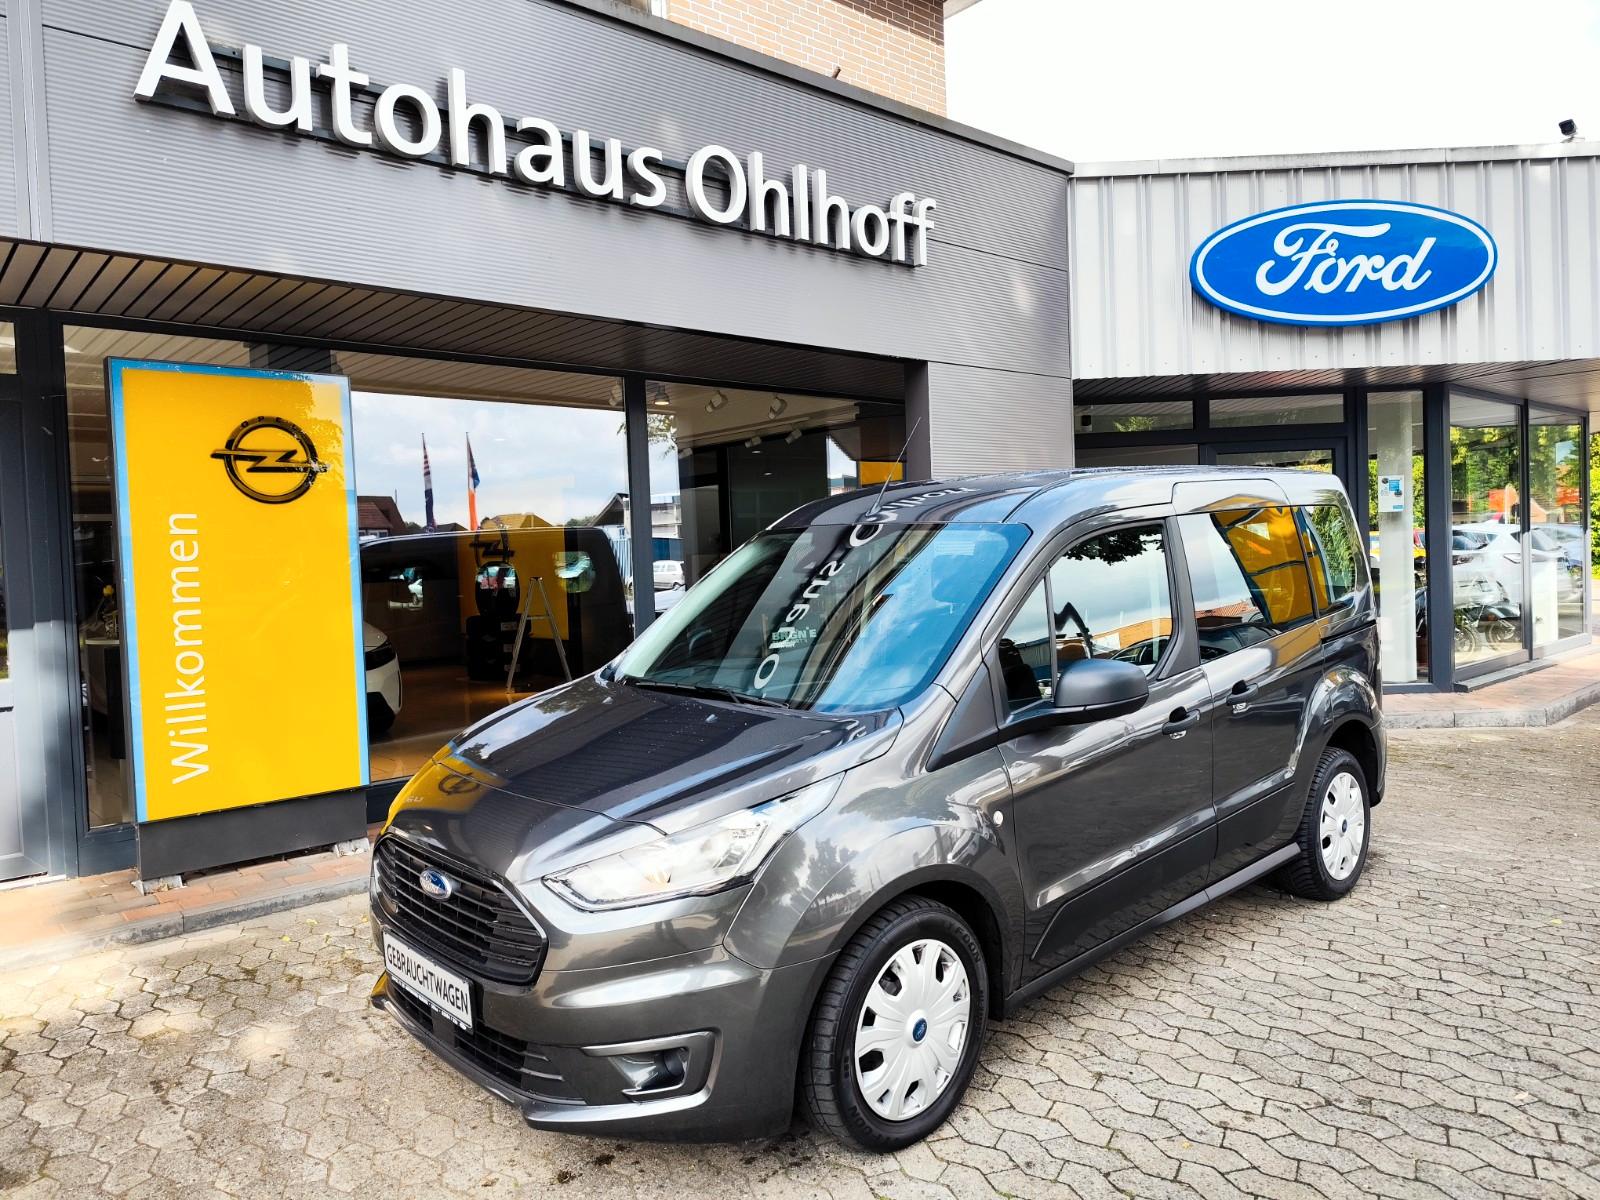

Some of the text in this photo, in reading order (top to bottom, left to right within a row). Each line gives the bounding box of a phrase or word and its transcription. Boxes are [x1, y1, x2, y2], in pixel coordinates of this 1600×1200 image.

[133, 0, 937, 268] Autohaus Ohlhoff
[1255, 222, 1437, 296] Ford
[164, 513, 209, 785] Willkommen
[386, 943, 469, 1015] GEBRAUCHTWAGEN
